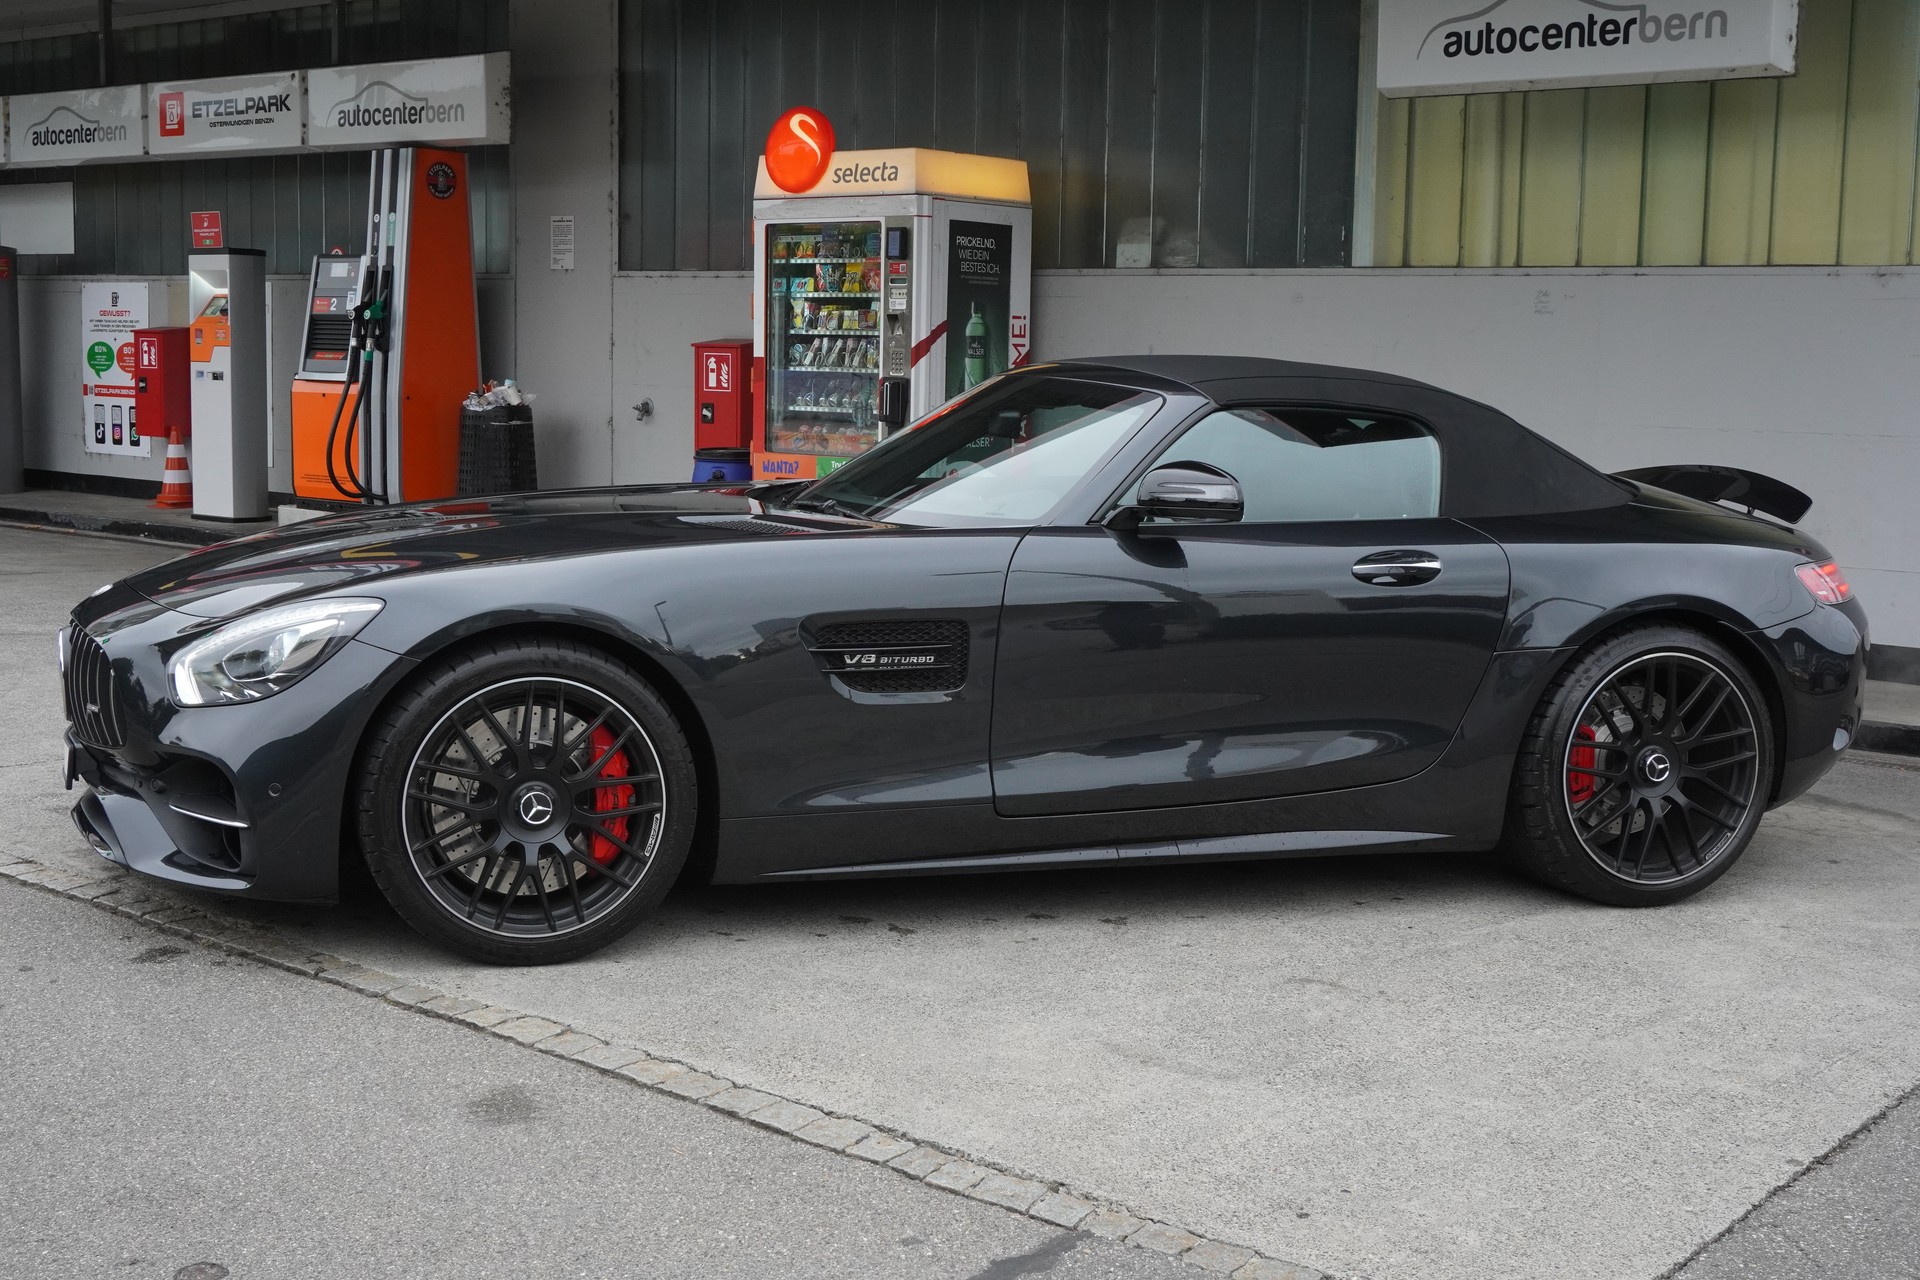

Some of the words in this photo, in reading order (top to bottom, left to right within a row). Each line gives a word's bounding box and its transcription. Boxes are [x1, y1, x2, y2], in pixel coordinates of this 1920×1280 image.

[1443, 9, 1728, 58] autocenterbern
[191, 93, 291, 118] ETZELPARK
[337, 102, 465, 127] autocenterbern
[209, 118, 254, 128] OSTERMUNDIGEN
[255, 117, 275, 125] BENZIN
[32, 124, 127, 147] autocenterbern
[832, 162, 899, 184] selecta
[956, 235, 996, 249] PRICKELND,
[958, 249, 972, 260] WIE
[972, 249, 990, 261] DEIN
[960, 261, 987, 273] BESTES
[330, 297, 337, 311] 2
[762, 459, 799, 475] WANTA?
[843, 654, 876, 664] V8
[880, 655, 935, 664] BITURBO
